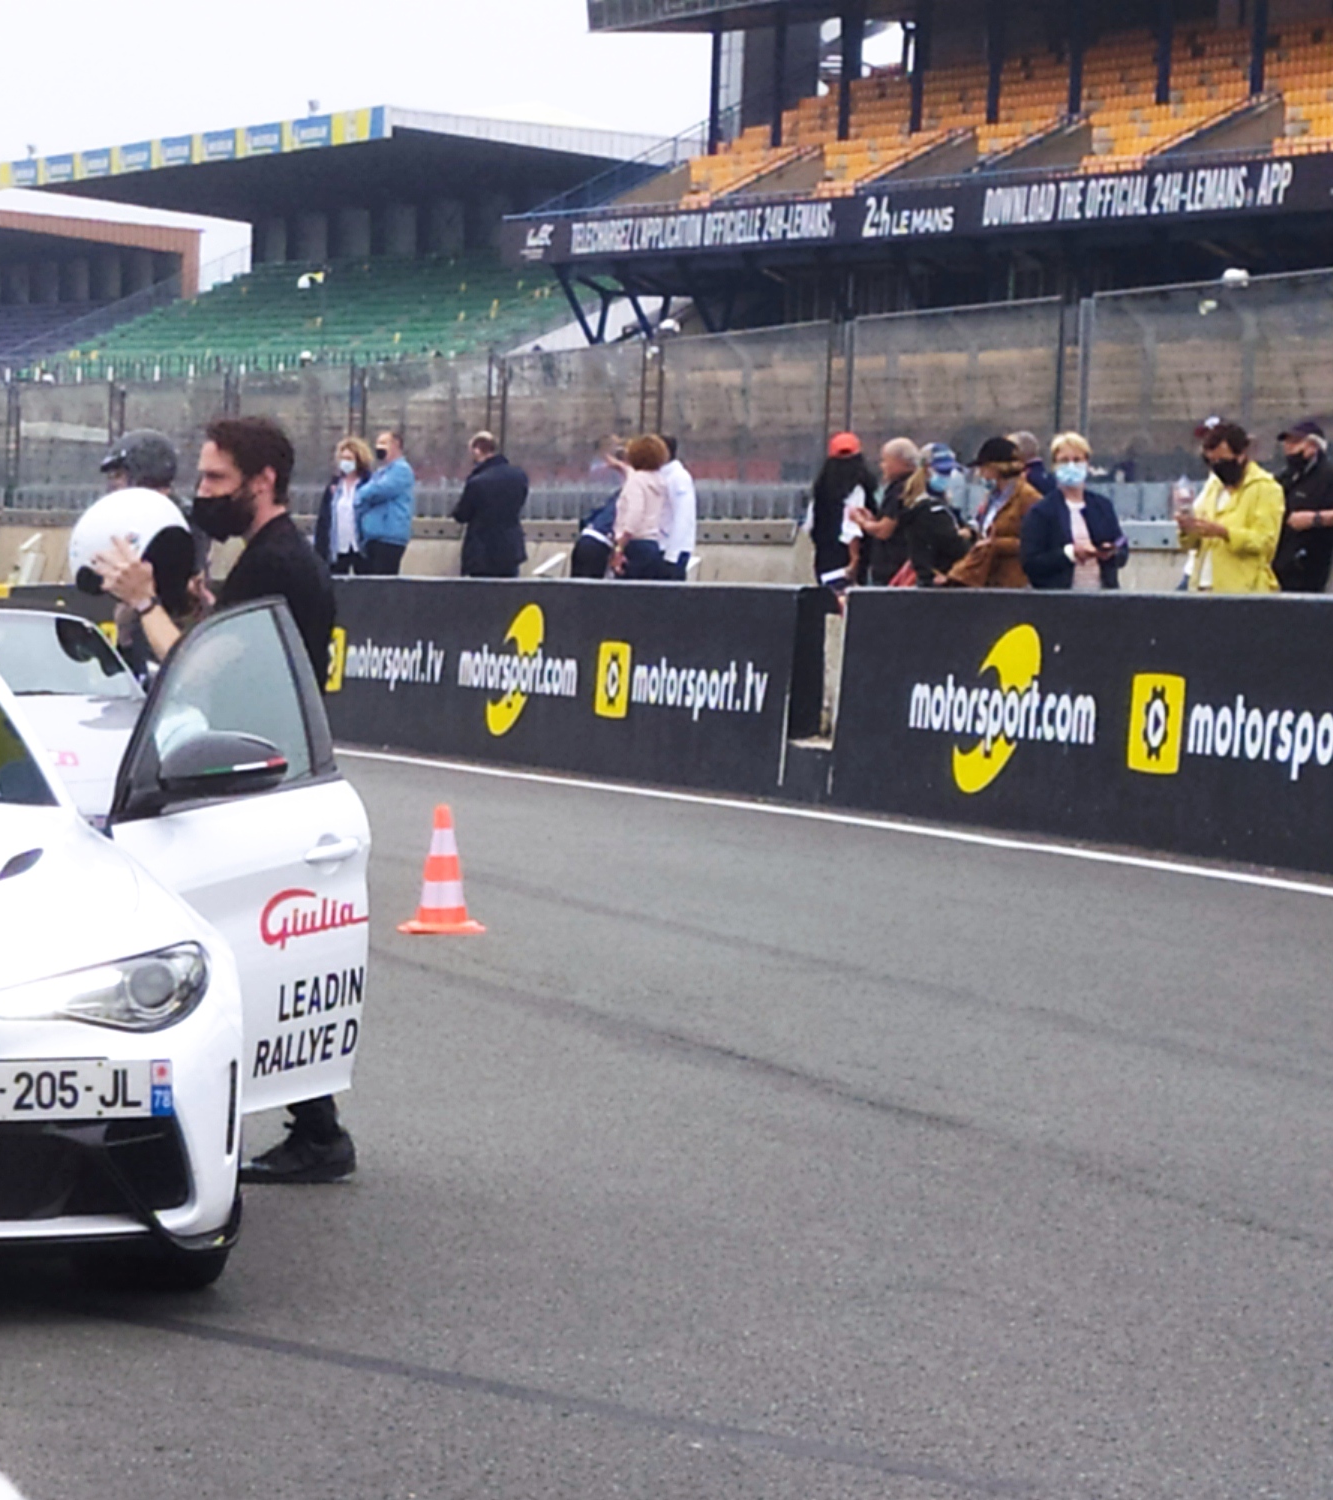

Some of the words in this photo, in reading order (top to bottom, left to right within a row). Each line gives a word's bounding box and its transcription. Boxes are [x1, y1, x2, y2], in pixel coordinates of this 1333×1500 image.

[910, 206, 955, 234] MANS
[982, 187, 1056, 226] DOWNLOAD
[1058, 179, 1084, 220] THE
[1085, 175, 1148, 219] OFFICIAL
[1256, 161, 1293, 207] APP
[345, 638, 445, 692] motorsport.tv
[457, 644, 578, 699] motorsport.com
[632, 657, 769, 722] motorsport.tv
[909, 674, 1096, 753] motorsport.com
[260, 888, 369, 950] Giulia
[278, 966, 364, 1023] LEADIN
[252, 1022, 337, 1078] RALLYE
[340, 1018, 358, 1057] D
[153, 1088, 172, 1108] 78
